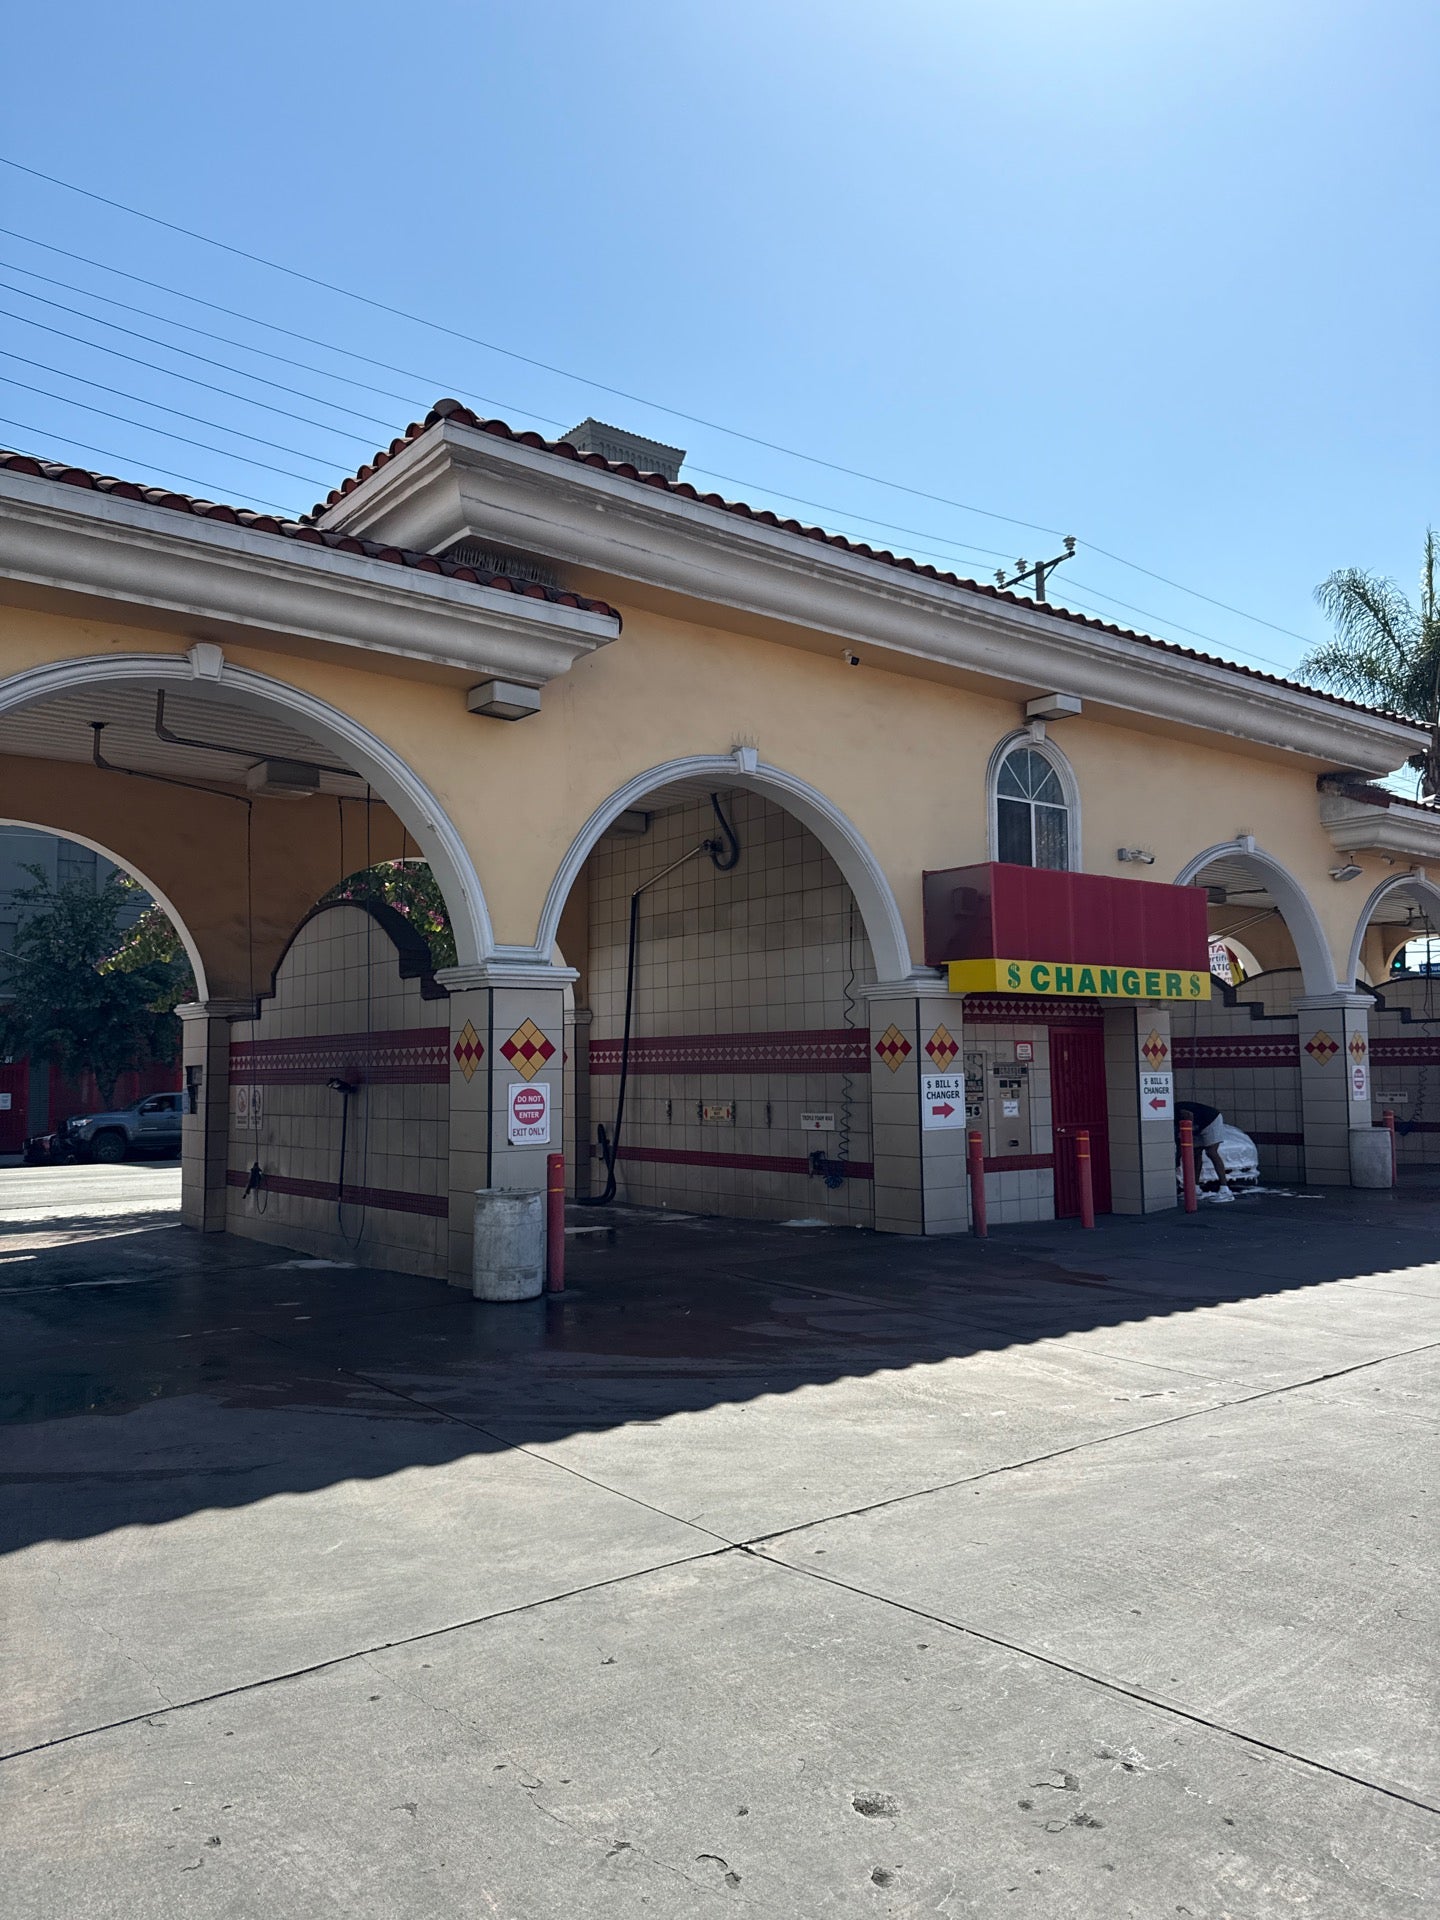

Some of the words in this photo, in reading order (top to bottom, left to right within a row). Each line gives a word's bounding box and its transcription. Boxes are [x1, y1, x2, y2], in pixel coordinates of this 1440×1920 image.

[1030, 965, 1182, 997] CHANGER
[926, 1080, 932, 1089] $
[935, 1080, 951, 1088] BILL
[954, 1079, 959, 1088] $
[1150, 1077, 1163, 1085] BILL
[1143, 1086, 1170, 1094] CHANGER
[926, 1090, 960, 1100] CHANGER
[512, 1128, 527, 1136] EXIT
[528, 1127, 545, 1136] ONLY
